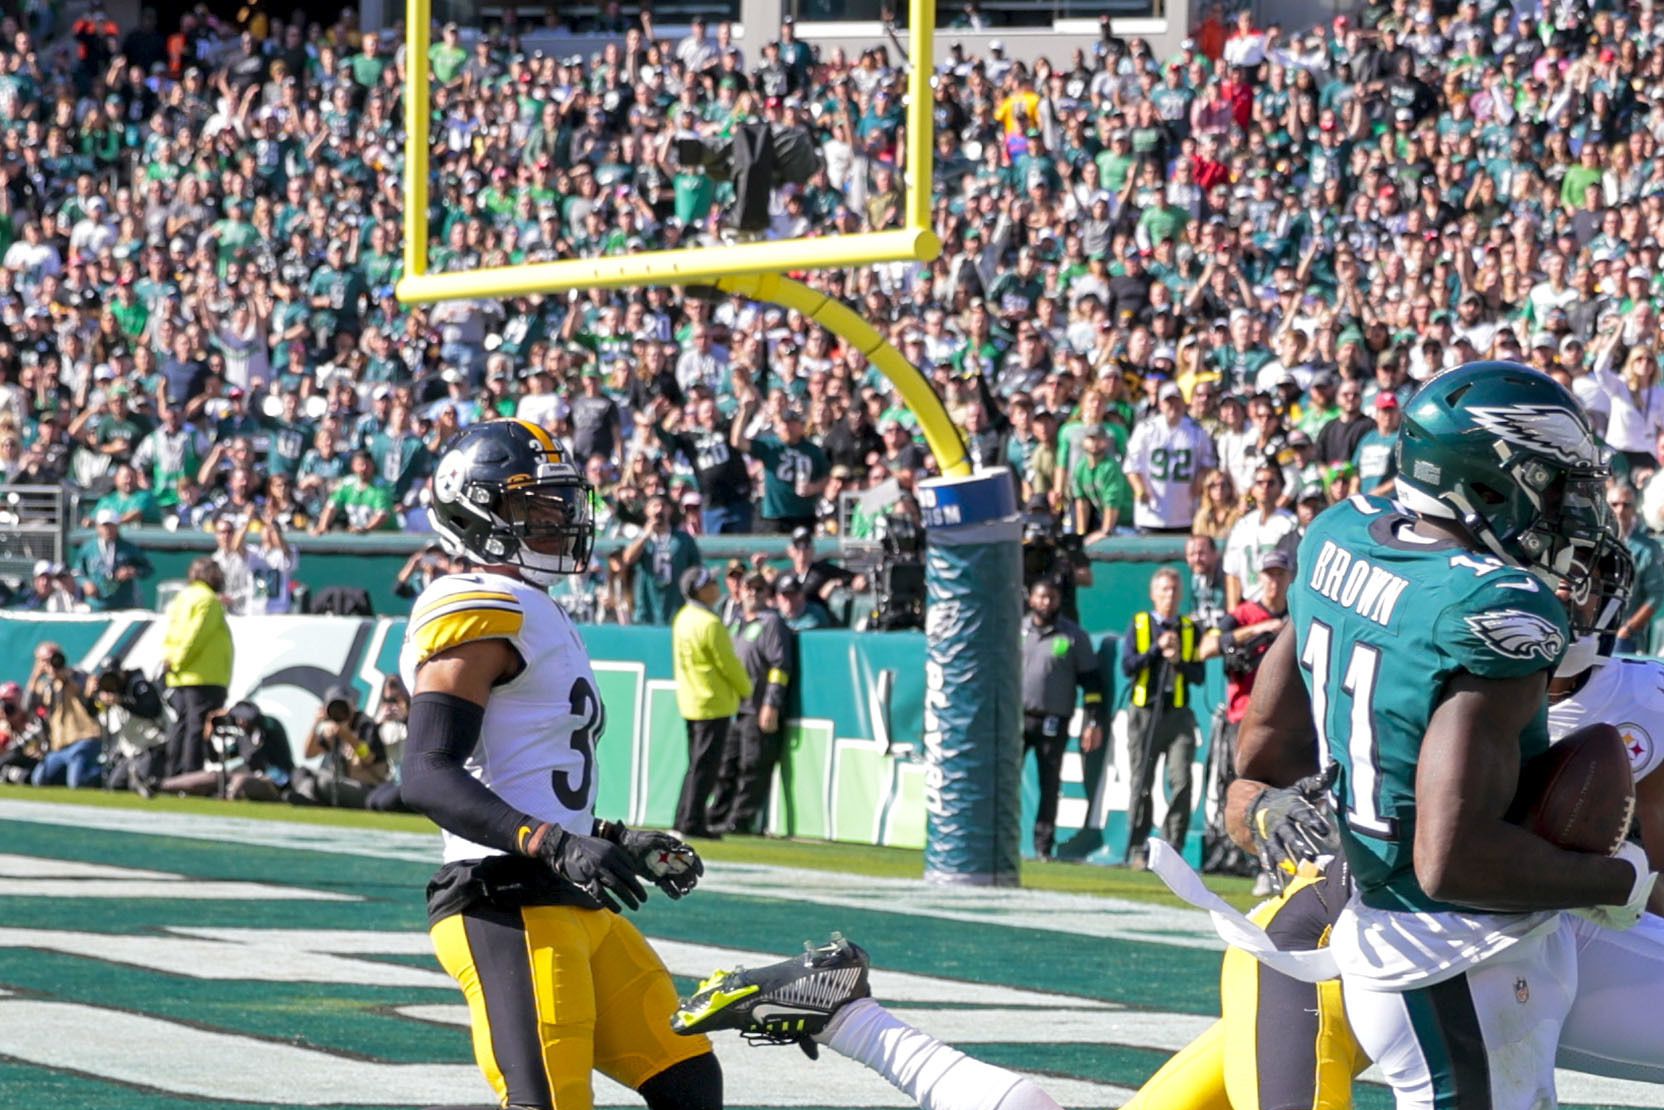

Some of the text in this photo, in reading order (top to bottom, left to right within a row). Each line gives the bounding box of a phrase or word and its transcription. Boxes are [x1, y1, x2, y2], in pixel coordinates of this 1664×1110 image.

[1151, 448, 1192, 482] 92
[1309, 539, 1410, 628] BROWN
[551, 676, 607, 818] 3
[1300, 615, 1401, 841] 11
